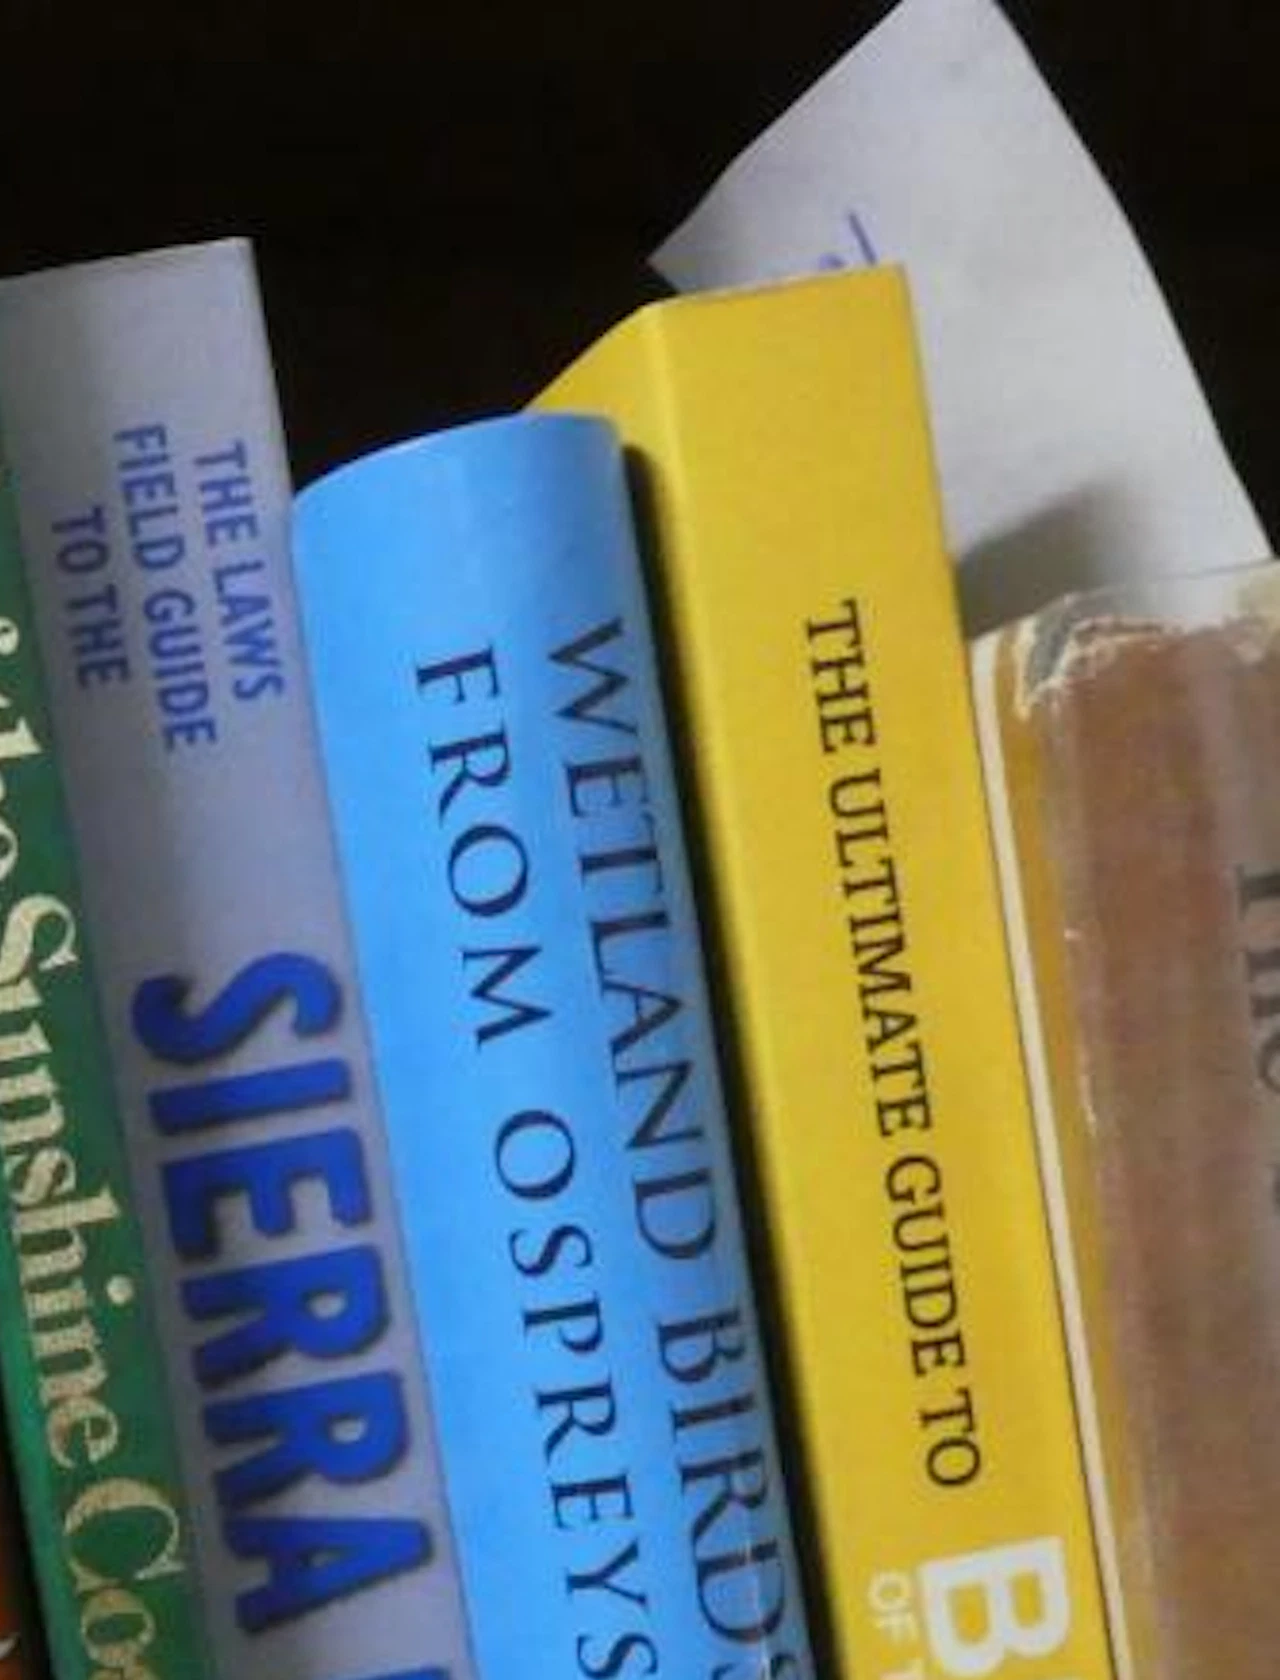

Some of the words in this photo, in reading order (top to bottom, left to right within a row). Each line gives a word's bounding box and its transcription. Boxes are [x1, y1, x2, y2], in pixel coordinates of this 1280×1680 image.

[50, 505, 109, 575] TO
[114, 421, 187, 571] FIELD
[195, 438, 260, 549] THE
[66, 582, 131, 691] THE
[143, 578, 217, 753] GUIDE
[214, 558, 286, 703] LAWS
[806, 598, 877, 755] THE
[415, 642, 555, 1053] FROM
[547, 615, 717, 1262] WETLAND
[827, 767, 932, 1139] ULTIMATE
[131, 951, 434, 1638] SIERRA
[884, 1153, 968, 1378] GUIDE
[918, 1385, 982, 1488] TO
[868, 1571, 919, 1645] OF
